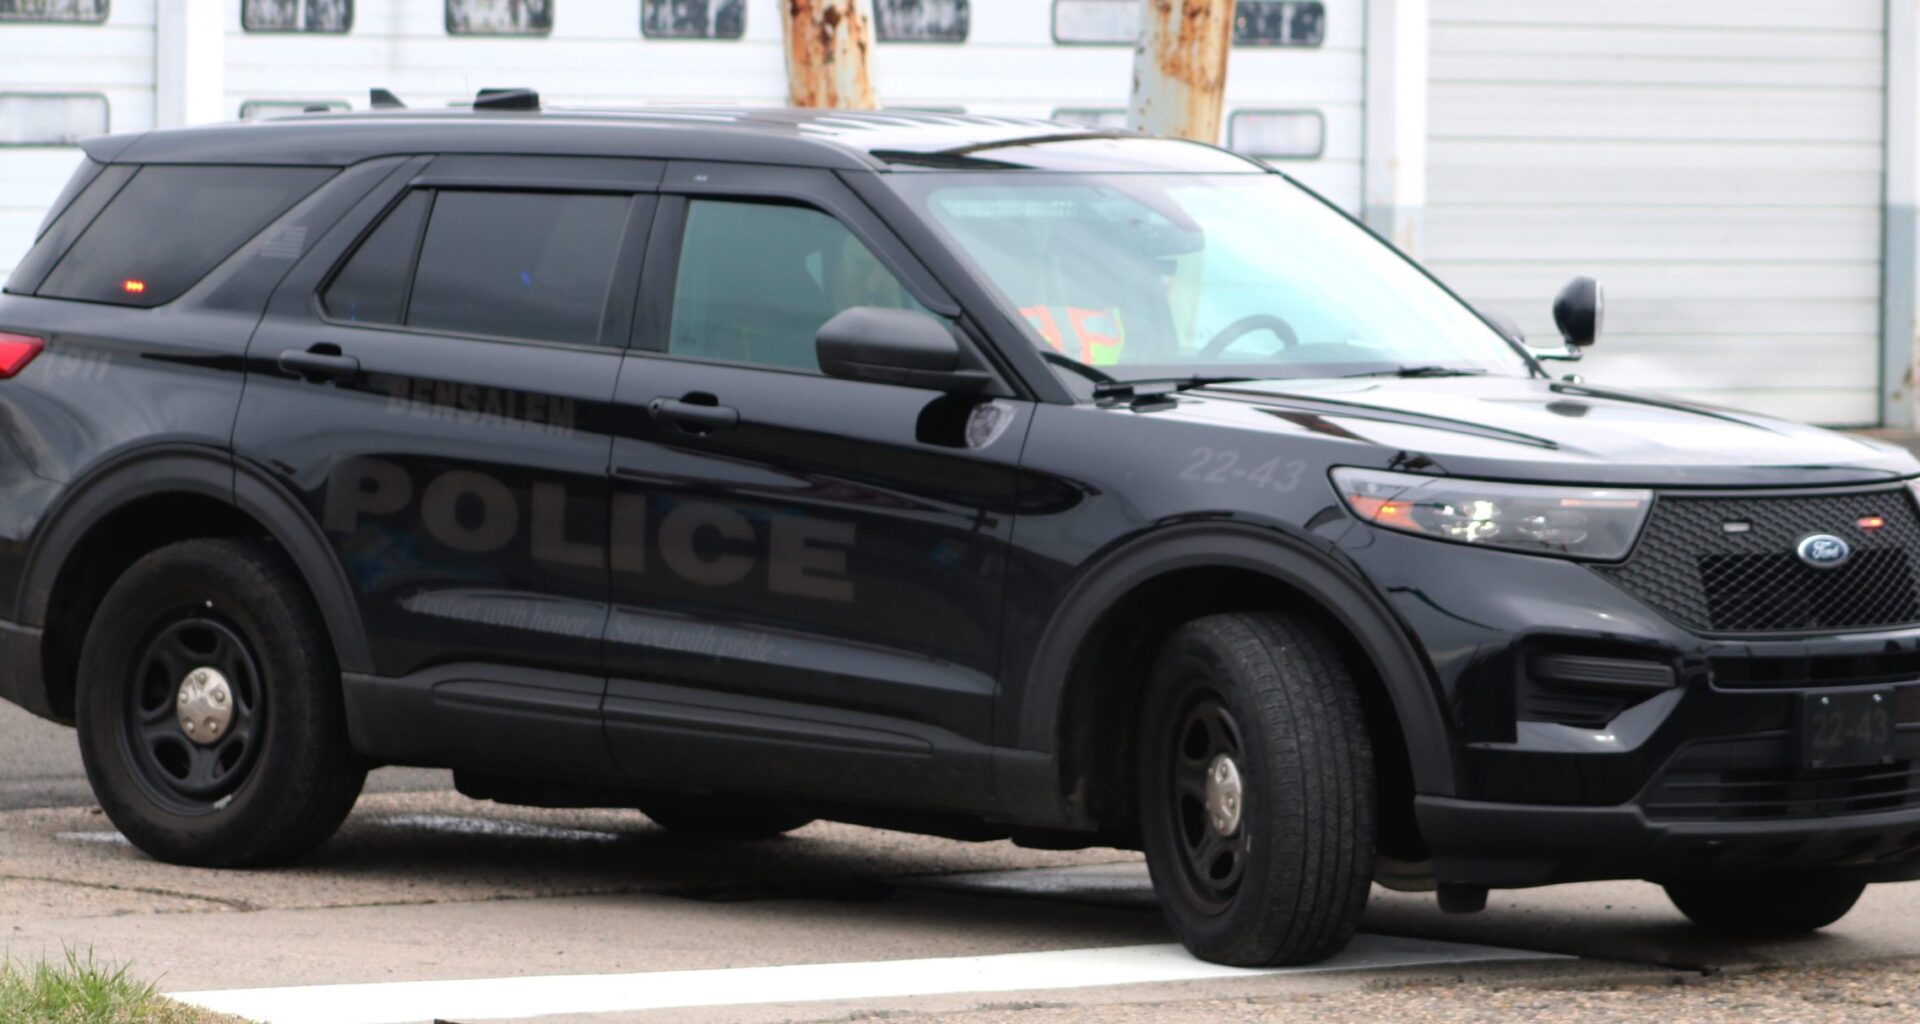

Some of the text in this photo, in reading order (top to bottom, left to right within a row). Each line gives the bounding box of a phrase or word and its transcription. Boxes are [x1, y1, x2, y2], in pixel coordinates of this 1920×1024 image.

[387, 374, 576, 437] BENSALEM
[1178, 445, 1307, 494] 22-43
[322, 454, 857, 601] POLICE
[1811, 706, 1890, 748] 22-43
